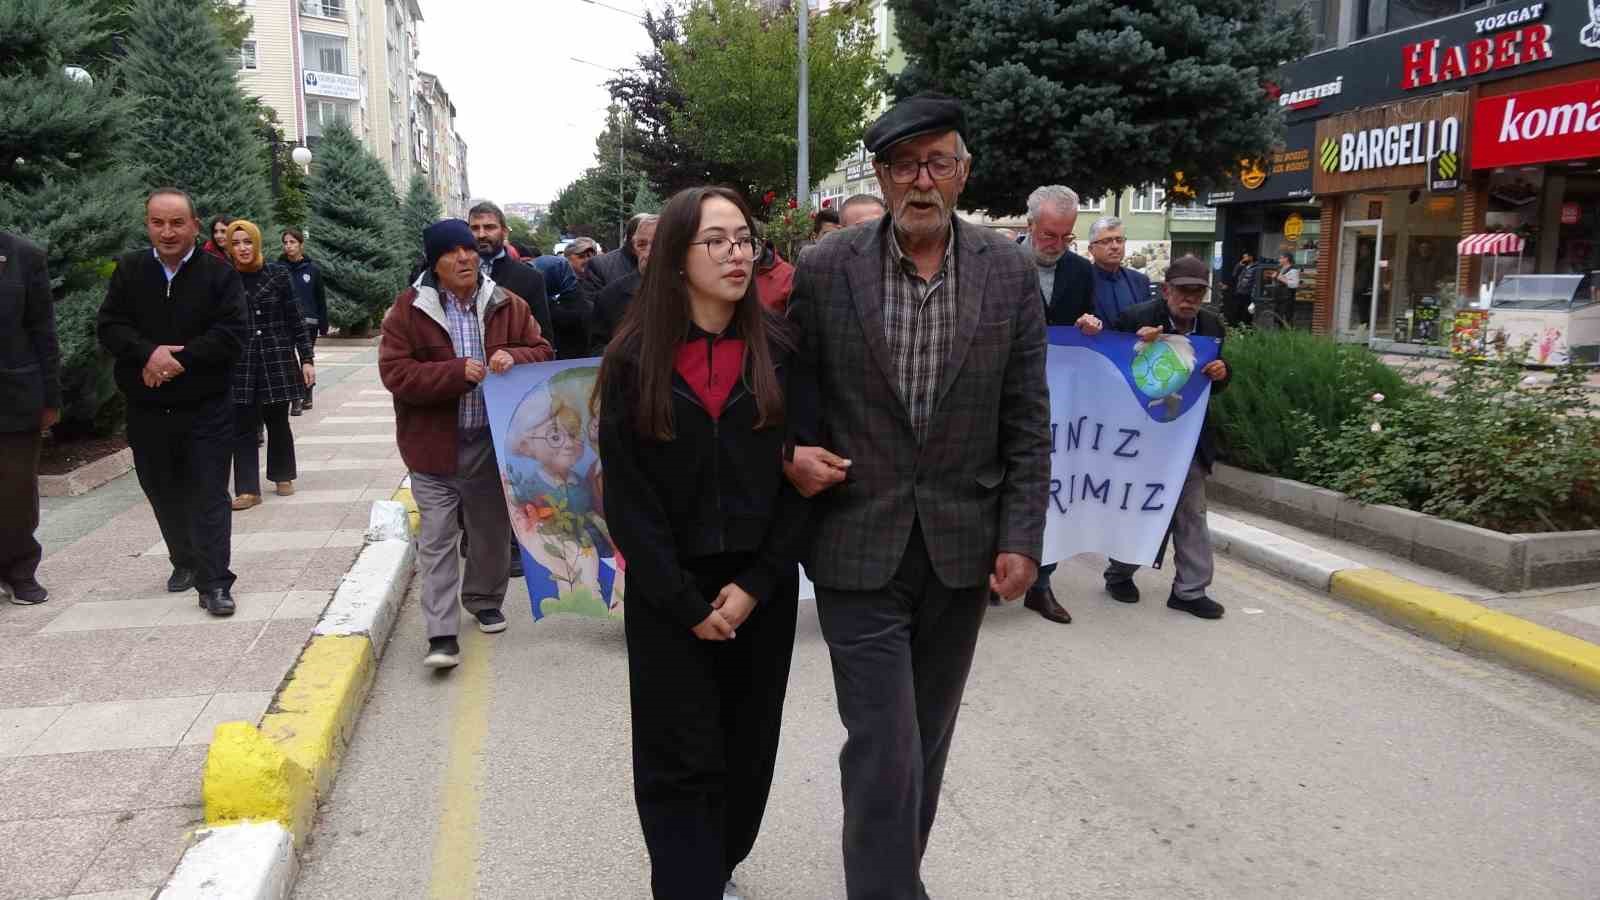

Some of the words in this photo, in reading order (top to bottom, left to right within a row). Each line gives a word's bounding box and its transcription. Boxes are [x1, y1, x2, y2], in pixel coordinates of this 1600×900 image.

[1475, 4, 1543, 33] YOZGAT
[1402, 24, 1552, 90] HABER
[1280, 76, 1343, 106] GAZETESİ
[1340, 117, 1458, 172] BARGELLO
